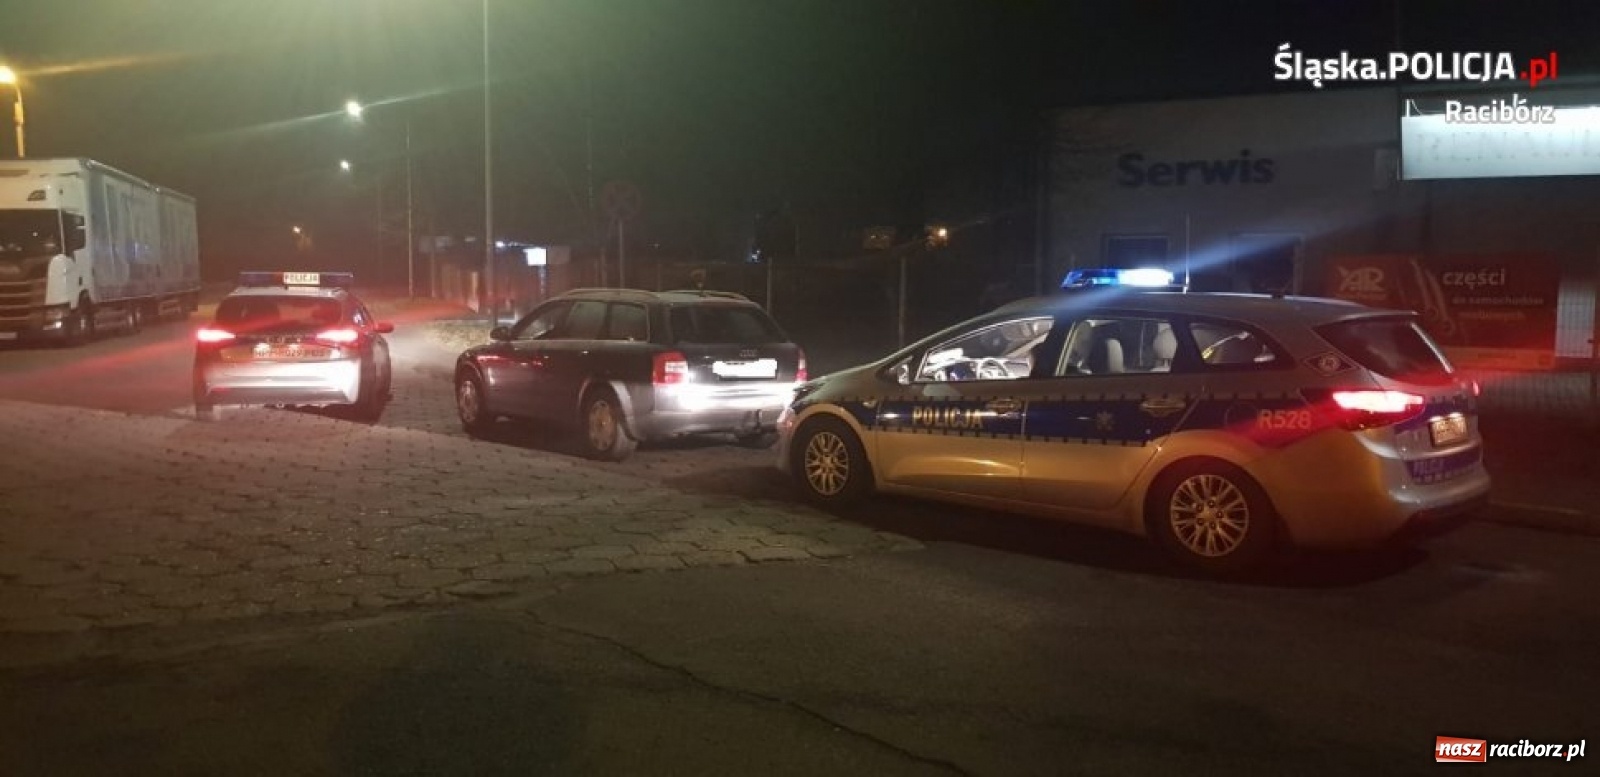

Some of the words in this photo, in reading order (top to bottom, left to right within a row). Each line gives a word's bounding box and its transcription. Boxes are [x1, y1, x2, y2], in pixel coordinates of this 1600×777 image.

[1117, 148, 1275, 188] Serwis
[283, 273, 319, 284] POLICJA
[1442, 267, 1505, 290] części
[912, 406, 983, 430] POLICJA
[1258, 408, 1312, 431] R528
